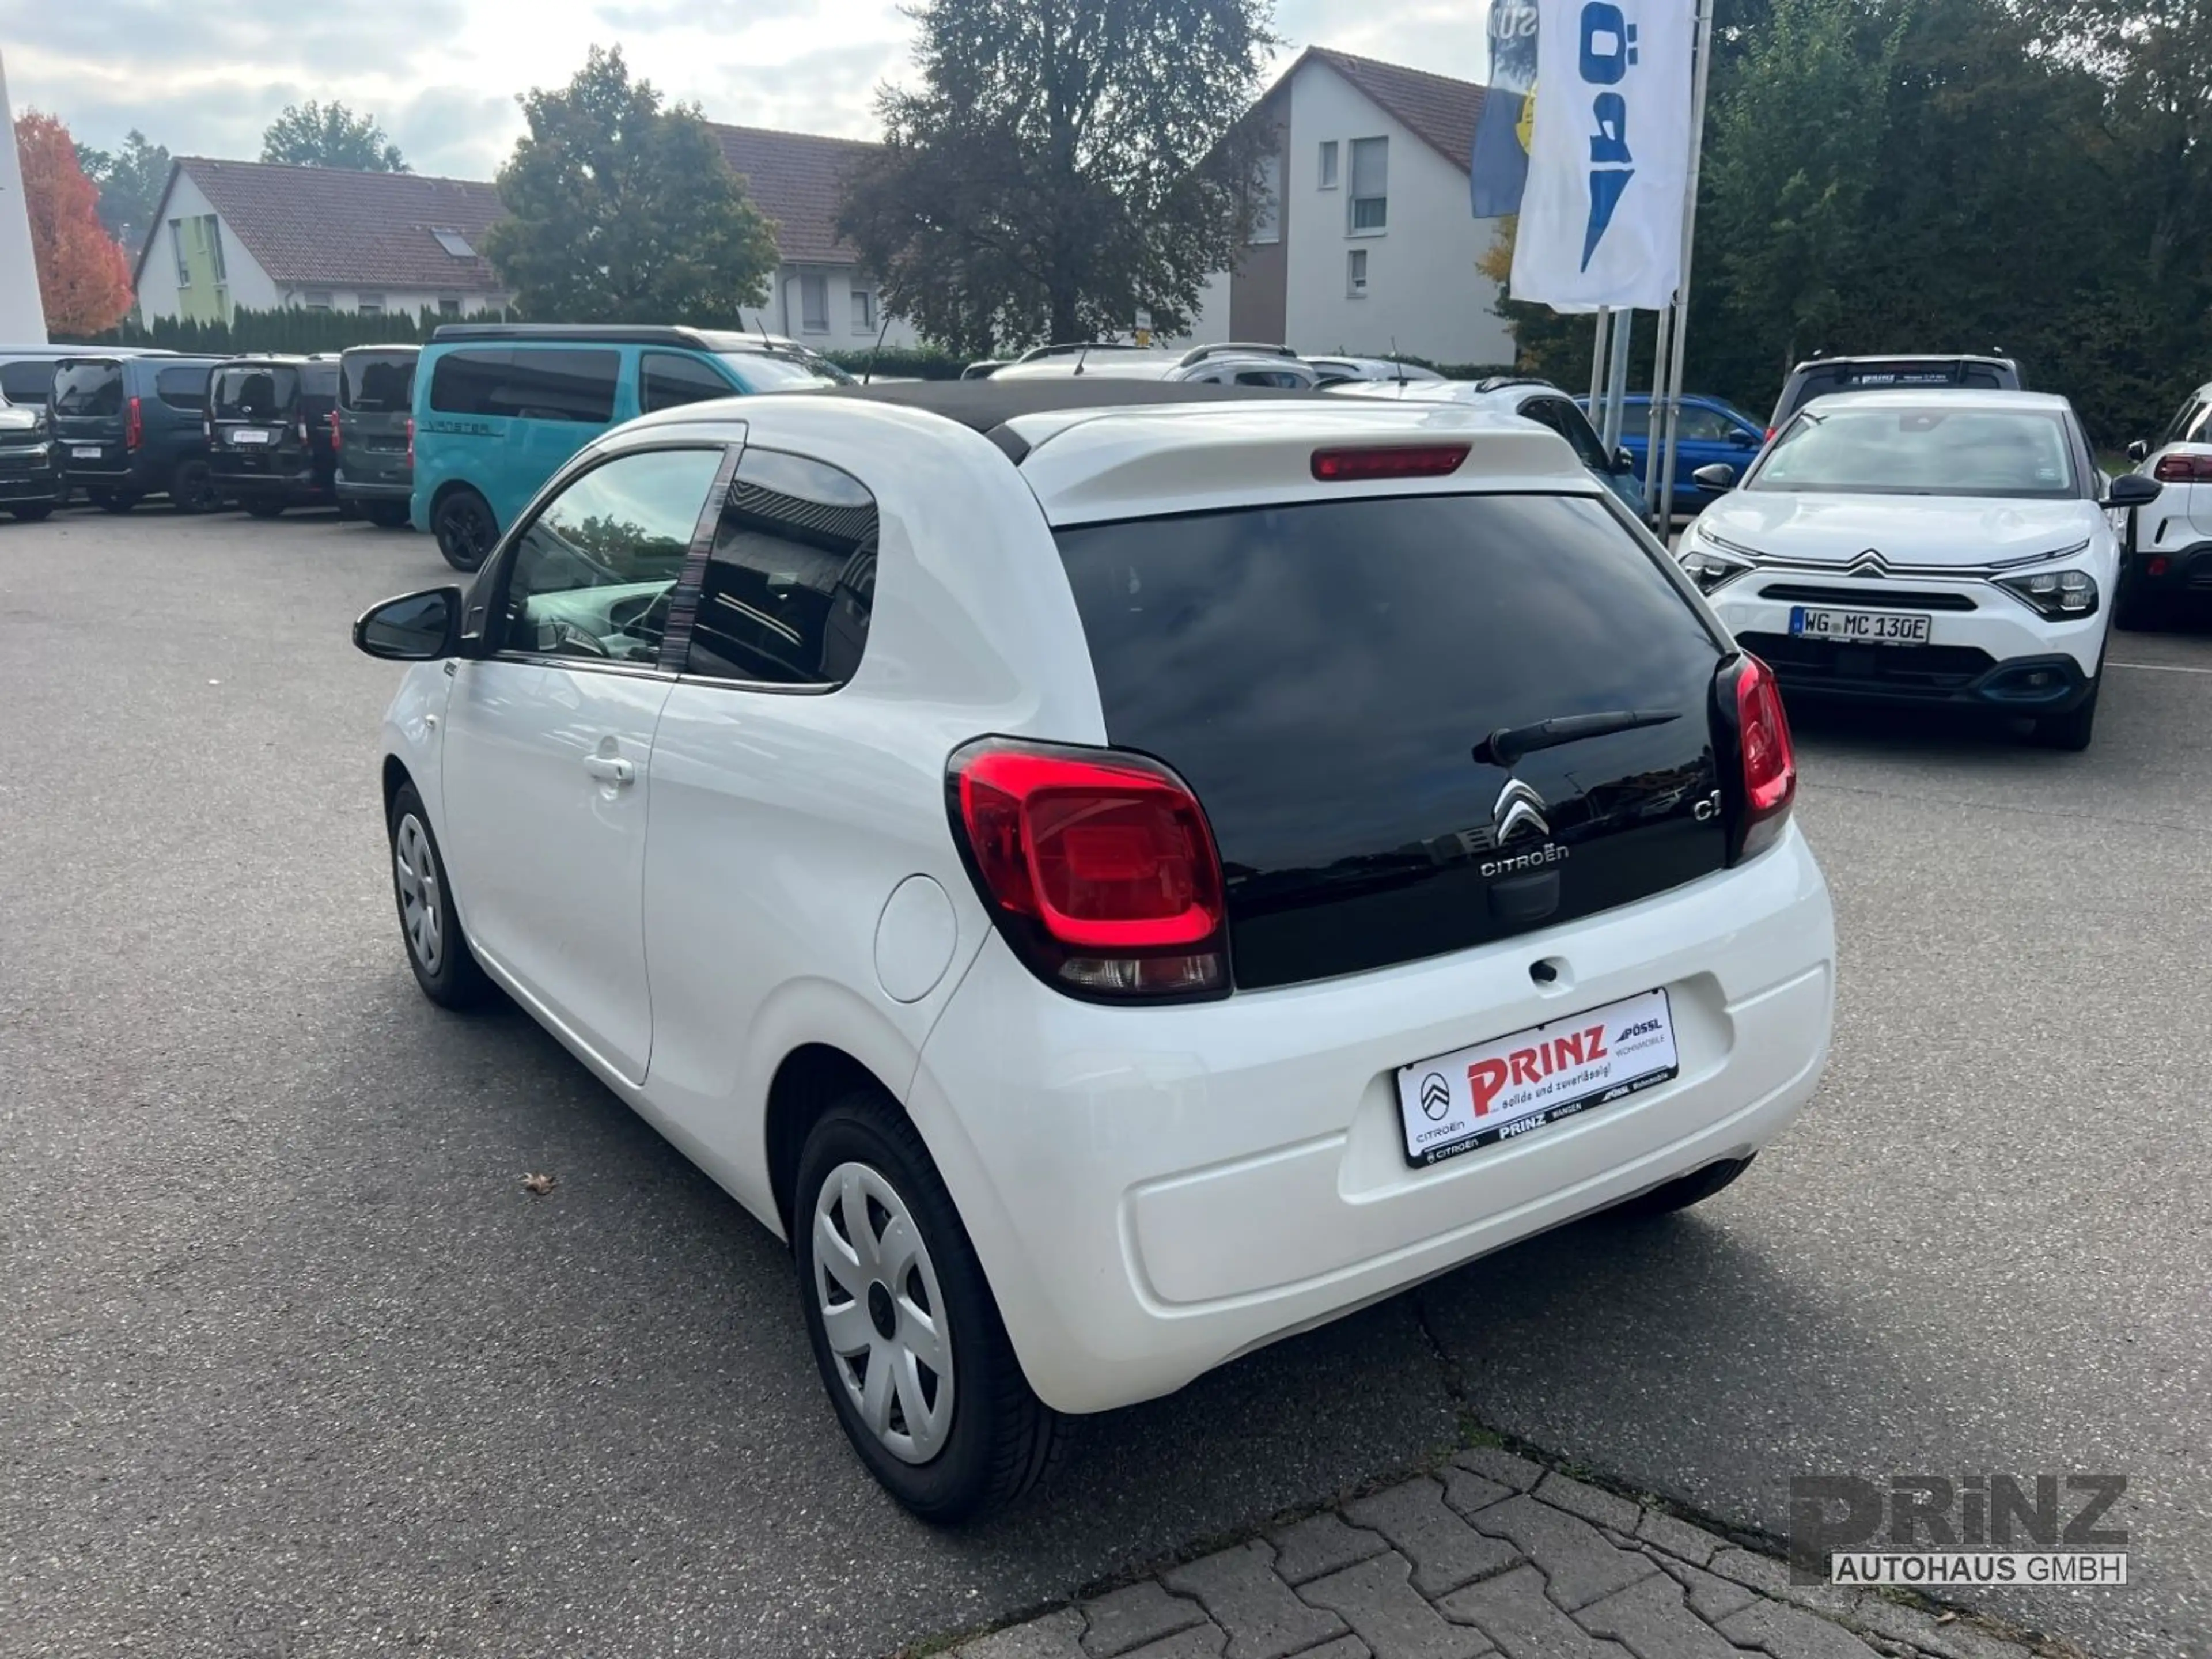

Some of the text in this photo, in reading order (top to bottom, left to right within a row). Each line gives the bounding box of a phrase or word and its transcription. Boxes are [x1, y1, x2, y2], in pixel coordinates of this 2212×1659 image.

[1805, 612, 1926, 639] WG MC 130E
[1623, 1018, 1663, 1040] PÖSSL
[1615, 1034, 1665, 1058] WOHNMOBILE
[1467, 1024, 1608, 1118] PRINZ
[1502, 1091, 1533, 1109] solide
[1536, 1082, 1553, 1099] und
[1556, 1062, 1612, 1091] zuverlässig!
[1498, 1113, 1547, 1140] PRINZ
[1552, 1103, 1582, 1118] WANGEN
